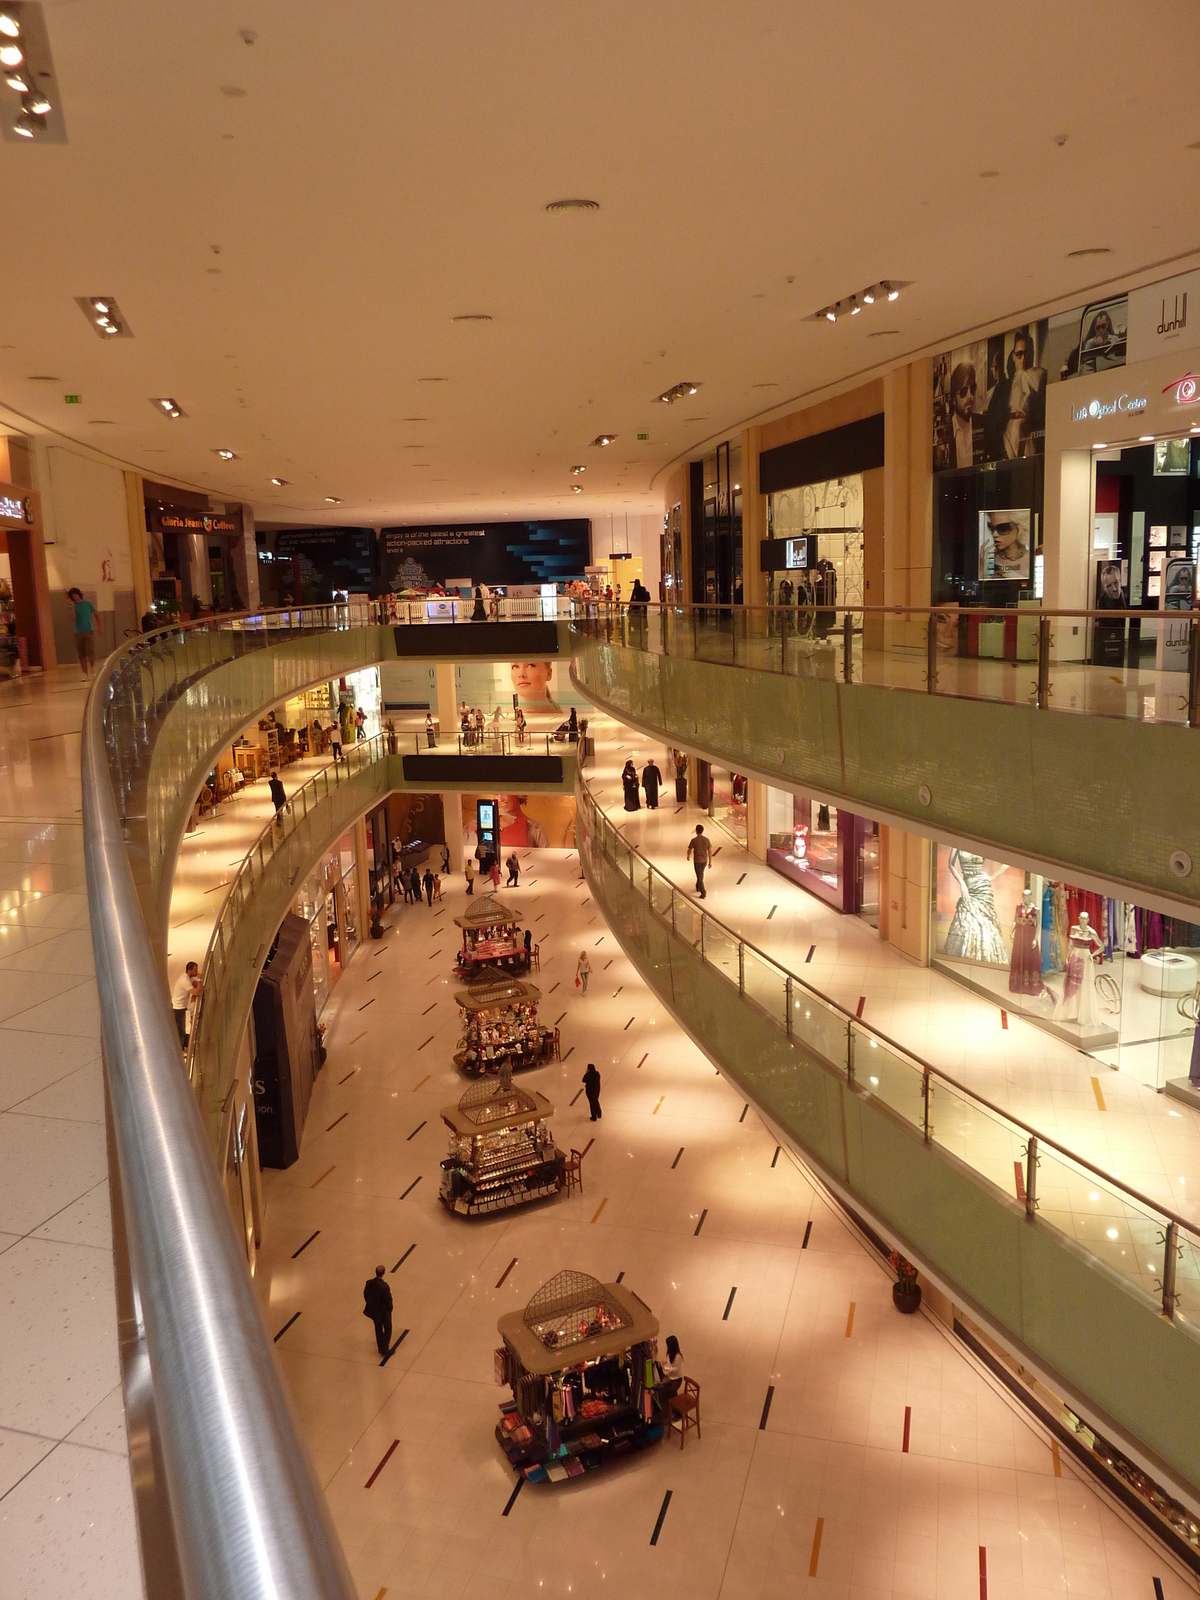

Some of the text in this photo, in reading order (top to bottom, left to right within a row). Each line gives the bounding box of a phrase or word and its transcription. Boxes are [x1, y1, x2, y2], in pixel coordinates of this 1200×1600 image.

[1157, 292, 1187, 335] dunhill
[1088, 400, 1117, 420] Optical
[1117, 393, 1148, 411] Centre
[161, 516, 235, 531] Gloria Jean's Coffees
[385, 532, 403, 540] enjoy
[455, 529, 486, 538] greatest
[386, 538, 470, 548] action-packed attractions
